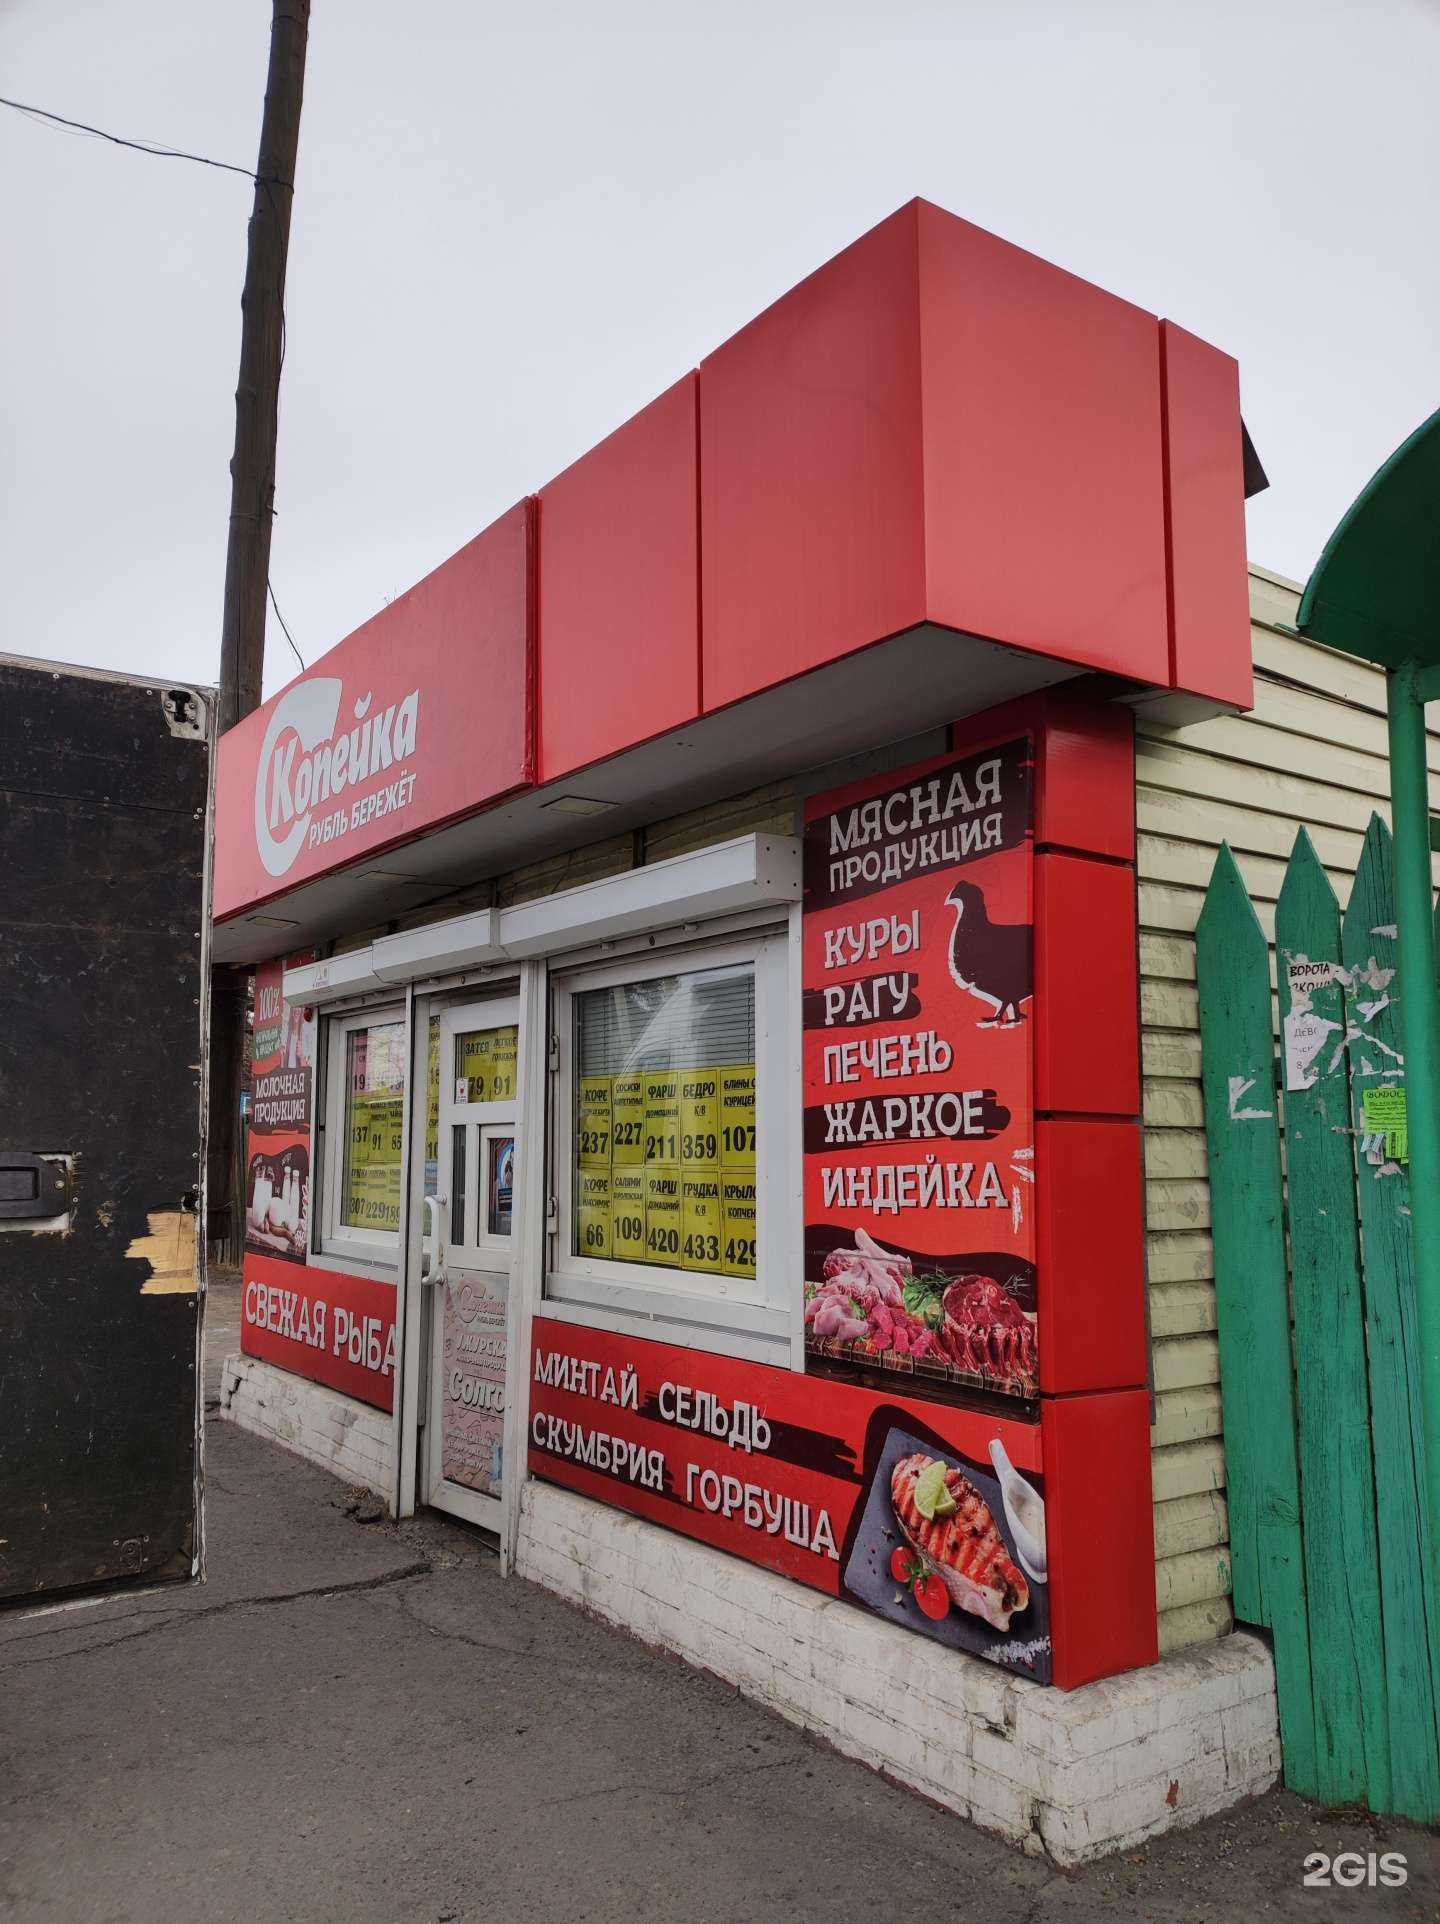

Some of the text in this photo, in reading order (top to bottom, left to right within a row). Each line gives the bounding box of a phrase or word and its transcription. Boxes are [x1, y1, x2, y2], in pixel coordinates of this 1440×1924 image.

[269, 688, 419, 830] Копейка
[308, 769, 417, 850] РУБЛЬ БЕРЕЖЁТ
[829, 758, 1002, 855] МЯСНАЯ
[829, 812, 1003, 893] ПРОДУКЦИЯ
[824, 909, 920, 969] КУРЫ
[1289, 964, 1330, 978] ВОРОТА
[260, 986, 281, 1021] 100%
[824, 972, 909, 1026] РАГУ
[823, 1030, 953, 1084] ПЕЧЕНЬ
[256, 1073, 305, 1099] МОЛОЧНАЯ
[585, 1089, 608, 1102] КОФЕ
[648, 1084, 676, 1098] ФАРШ
[683, 1082, 716, 1098] БЕДРО
[723, 1079, 750, 1089] БЛИНЫ
[254, 1099, 306, 1126] ПРОДУКЦИЯ
[823, 1090, 985, 1143] ЖАРКОЕ
[582, 1132, 608, 1153] 237
[615, 1122, 642, 1145] 227
[647, 1135, 675, 1158] 211
[683, 1134, 716, 1159] 359
[722, 1125, 755, 1151] 107
[584, 1178, 608, 1192] КОФЕ
[649, 1180, 677, 1194] ФАРШ
[683, 1183, 718, 1198] ГРУДКА
[821, 1154, 1010, 1215] ИНДЕЙКА
[614, 1216, 642, 1240] 109
[648, 1228, 679, 1254] 420
[684, 1234, 719, 1261] 433
[245, 1281, 398, 1376] СВЕЖАЯ РЫБА
[533, 1348, 772, 1453] МИНТАЙ СЕЛЬДЬ
[531, 1411, 841, 1561] СКУМБРИЯ ГОРБУША
